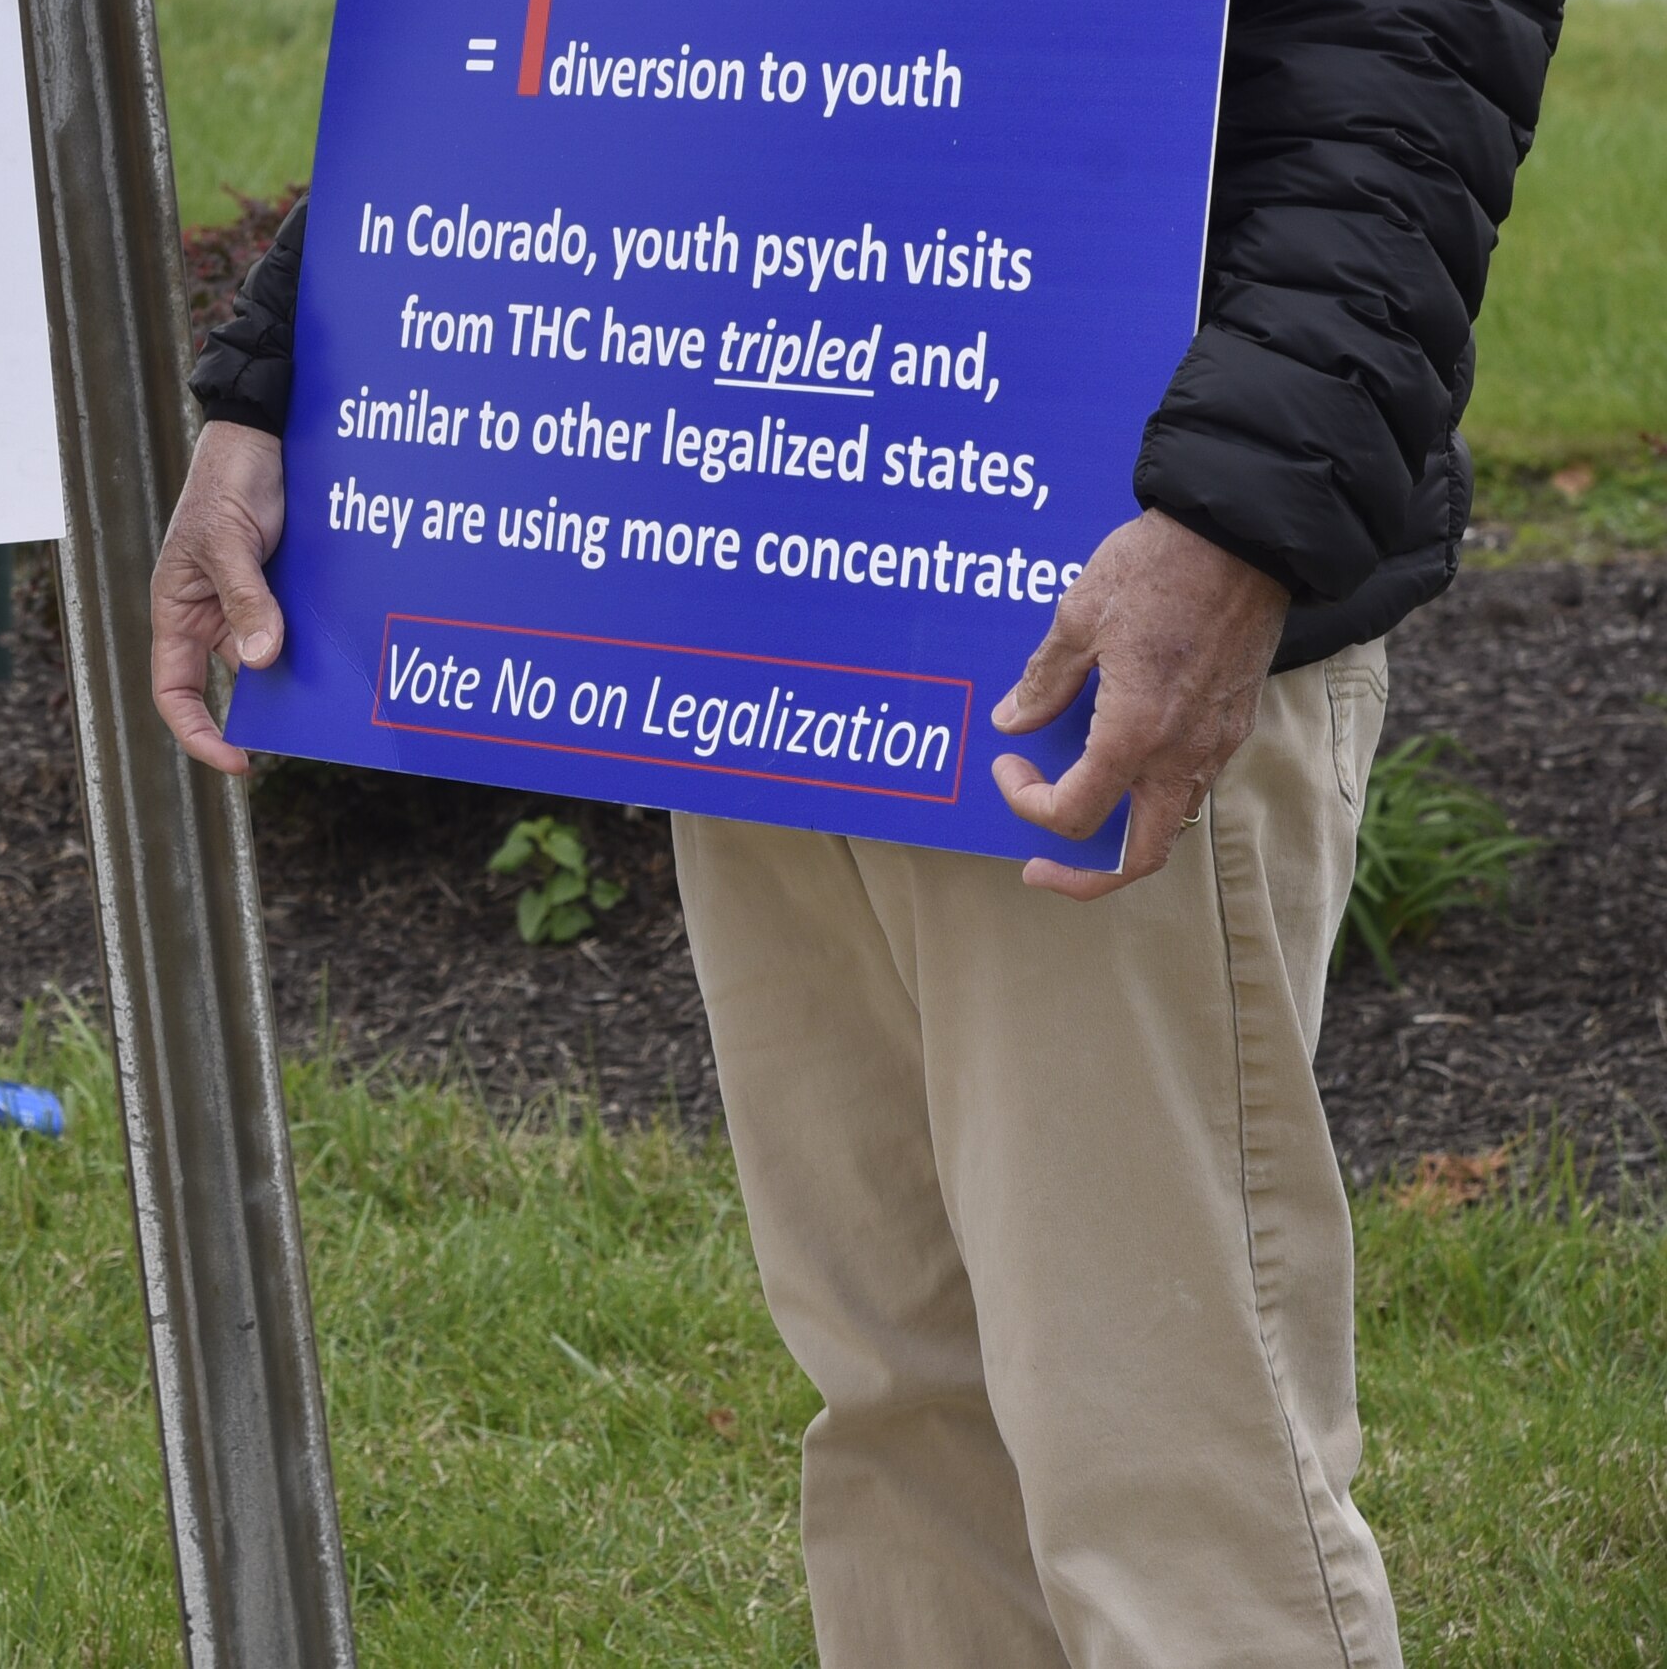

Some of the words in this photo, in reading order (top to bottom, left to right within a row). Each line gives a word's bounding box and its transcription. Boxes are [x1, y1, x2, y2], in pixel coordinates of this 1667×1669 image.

[548, 40, 745, 101] diversion
[759, 51, 807, 103] to
[821, 48, 962, 118] youth
[359, 202, 395, 255] In
[406, 203, 597, 276] Colorado,
[612, 215, 739, 281] youth
[752, 222, 888, 293] psych
[903, 228, 1032, 292] visits
[400, 293, 494, 354] from
[507, 303, 591, 361] THC
[600, 306, 706, 370] have
[717, 318, 881, 391] tripled
[890, 330, 1000, 403] and,
[337, 385, 470, 447] similar
[478, 400, 520, 452] to
[532, 400, 652, 462] other
[662, 407, 869, 483] legalized
[882, 435, 1049, 511] states,
[329, 476, 414, 549] they
[421, 499, 486, 544] are
[497, 496, 610, 570] using
[620, 518, 741, 570] more
[389, 644, 481, 711] Vote
[491, 657, 556, 720] No
[569, 681, 628, 730] on
[642, 675, 950, 772] Legalization
